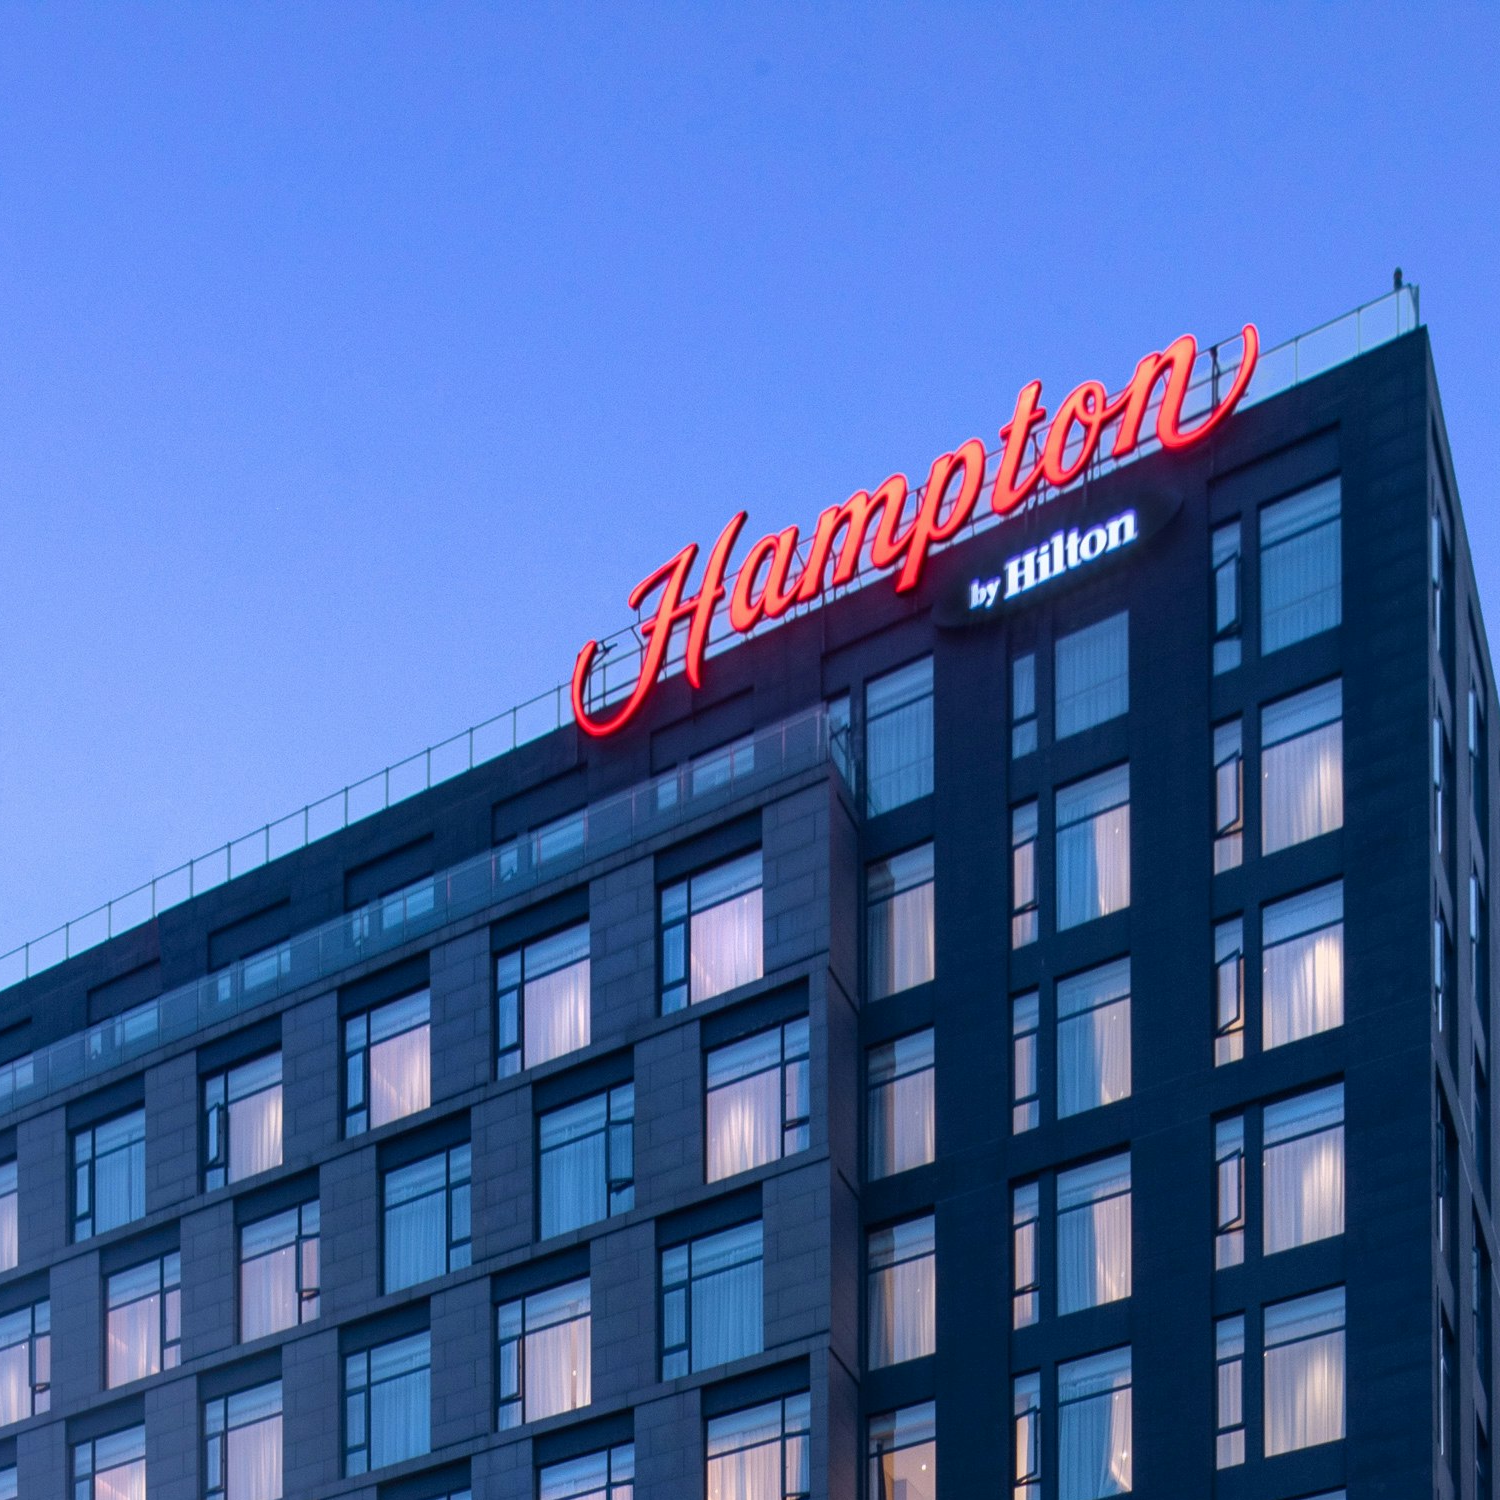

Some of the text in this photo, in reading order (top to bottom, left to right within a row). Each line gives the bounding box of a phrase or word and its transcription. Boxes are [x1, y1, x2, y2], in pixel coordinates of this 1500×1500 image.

[571, 323, 1260, 737] Hampton
[970, 508, 1138, 609] by Hilton
